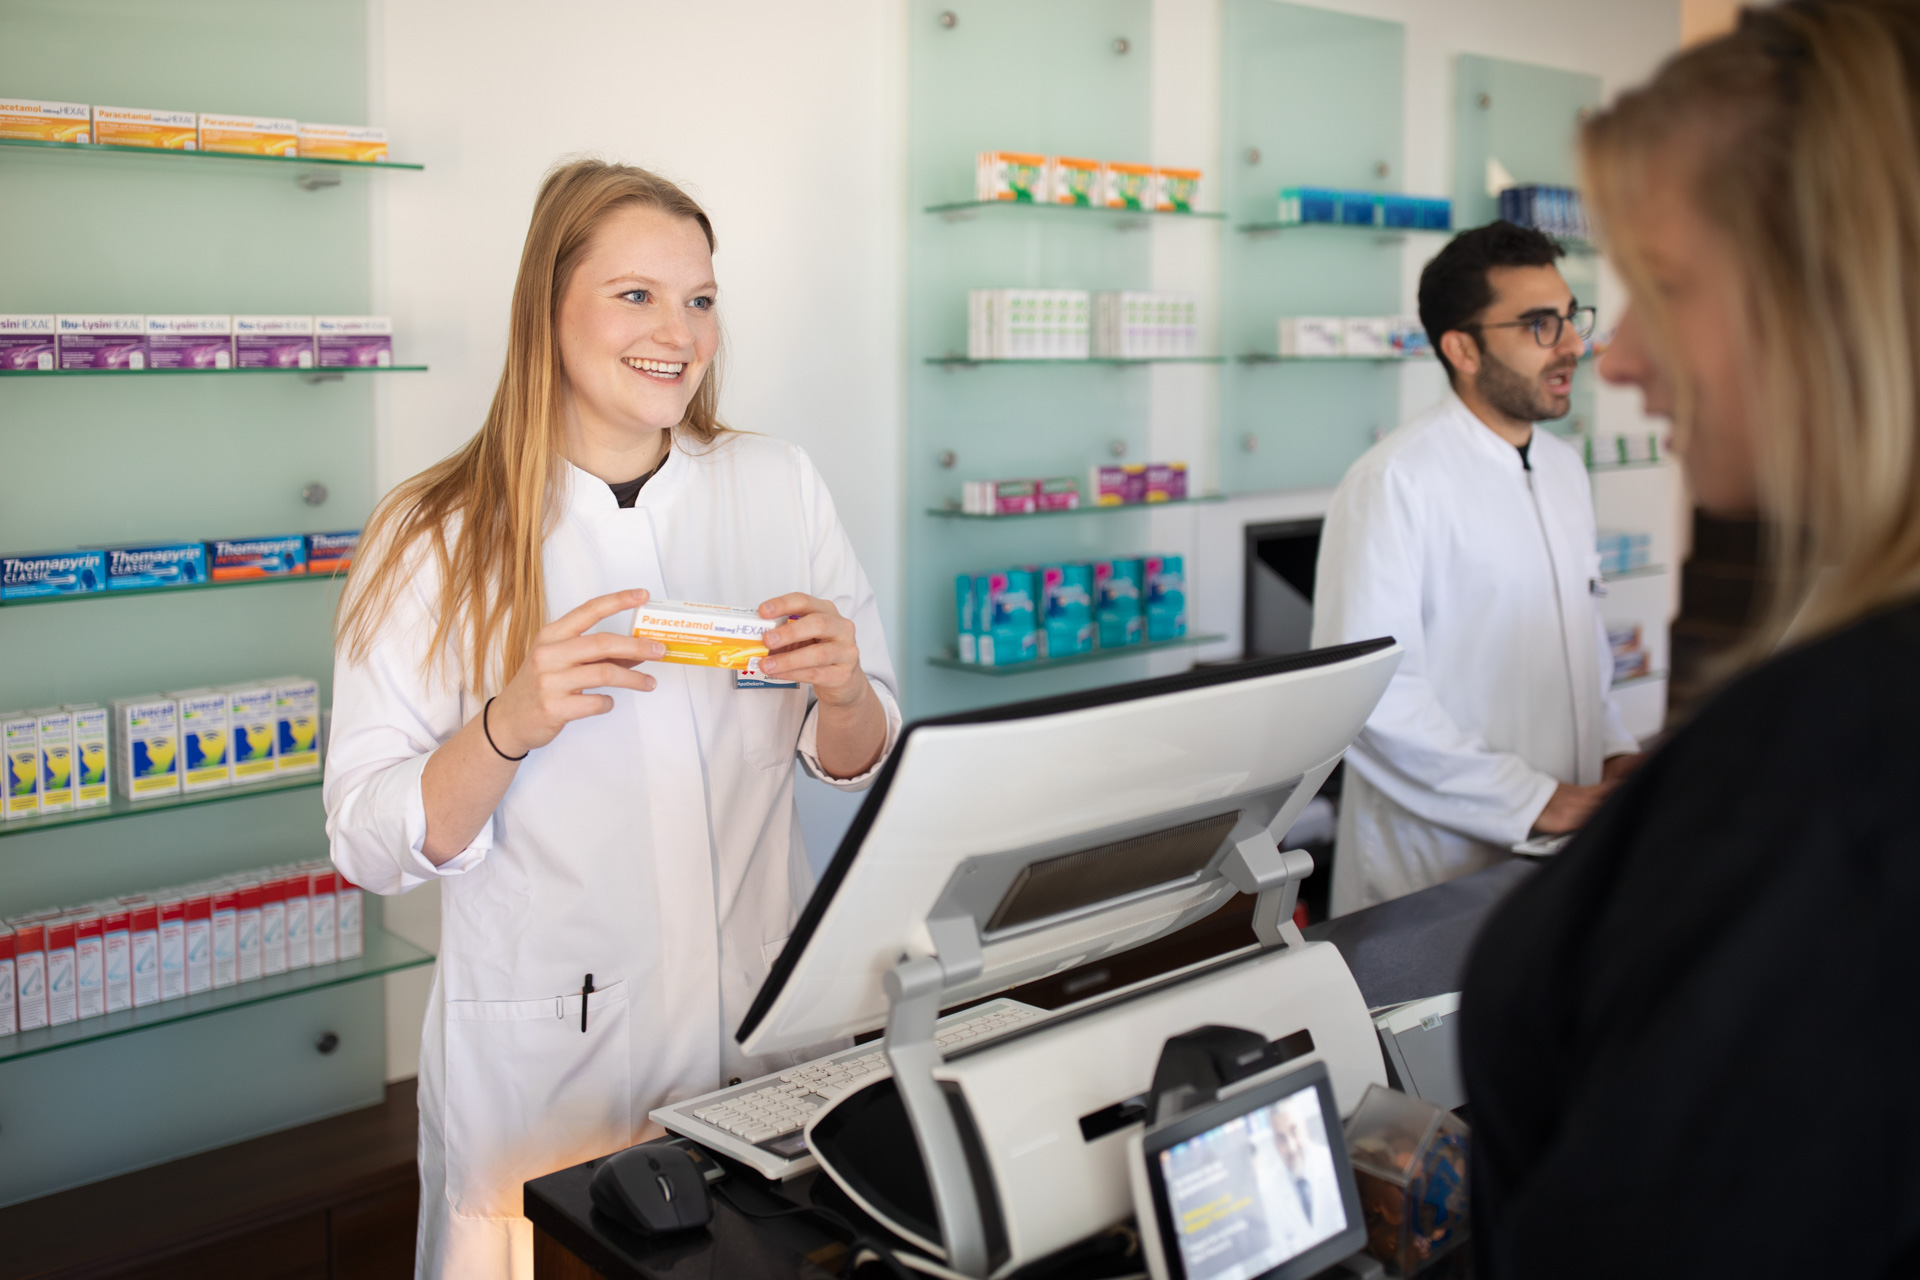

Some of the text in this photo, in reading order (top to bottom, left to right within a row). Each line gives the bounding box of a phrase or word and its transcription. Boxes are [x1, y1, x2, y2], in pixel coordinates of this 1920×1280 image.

[98, 109, 152, 121] Paracetamol
[204, 117, 255, 129] Paracetamol
[110, 546, 200, 564] Thomapyrin
[215, 538, 301, 557] Thomapyrin
[3, 553, 100, 573] Thomapyrin
[110, 561, 155, 575] CLASSIC
[3, 570, 51, 584] CLASSIC
[641, 614, 714, 631] Paracetamol
